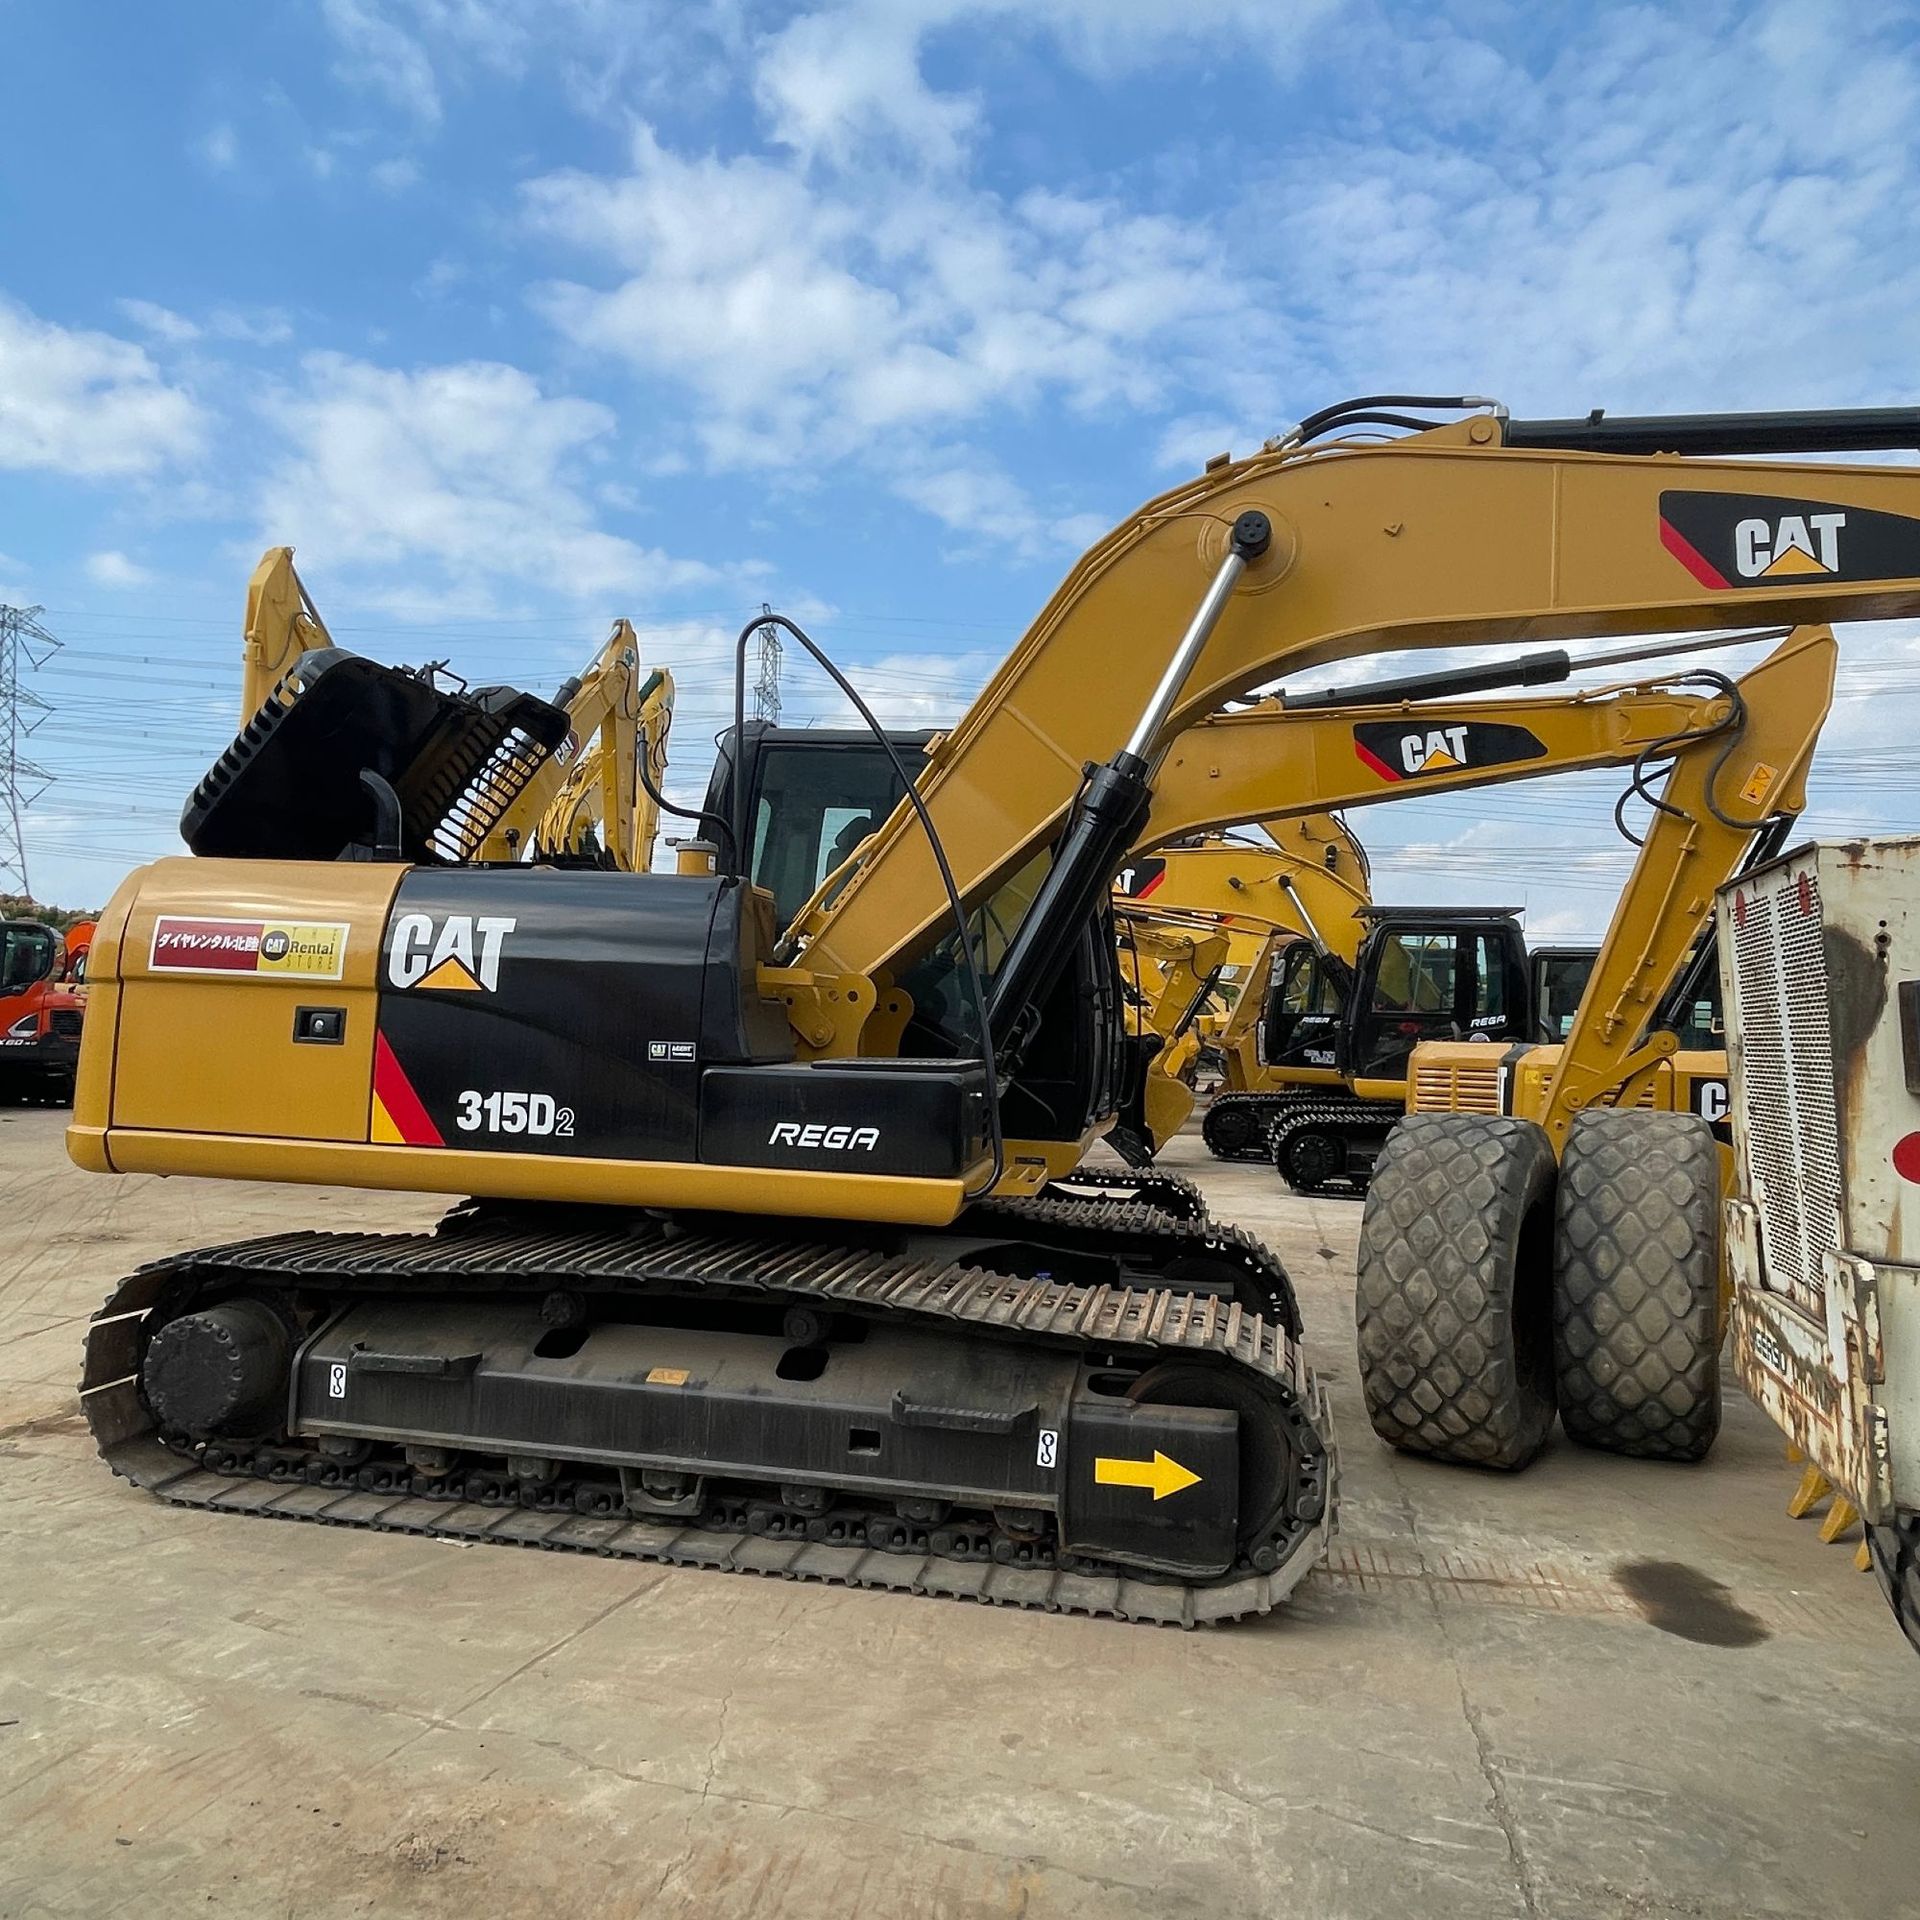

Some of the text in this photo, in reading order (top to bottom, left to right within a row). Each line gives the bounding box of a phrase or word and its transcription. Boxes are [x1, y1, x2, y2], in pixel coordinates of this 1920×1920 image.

[1735, 513, 1846, 578] CAT
[1400, 726, 1469, 773] CAT
[265, 938, 286, 954] CAT
[290, 941, 335, 955] Rental
[388, 914, 517, 992] CAT
[286, 954, 333, 970] STORE
[1469, 1014, 1507, 1028] REGA
[768, 1122, 880, 1151] REGA
